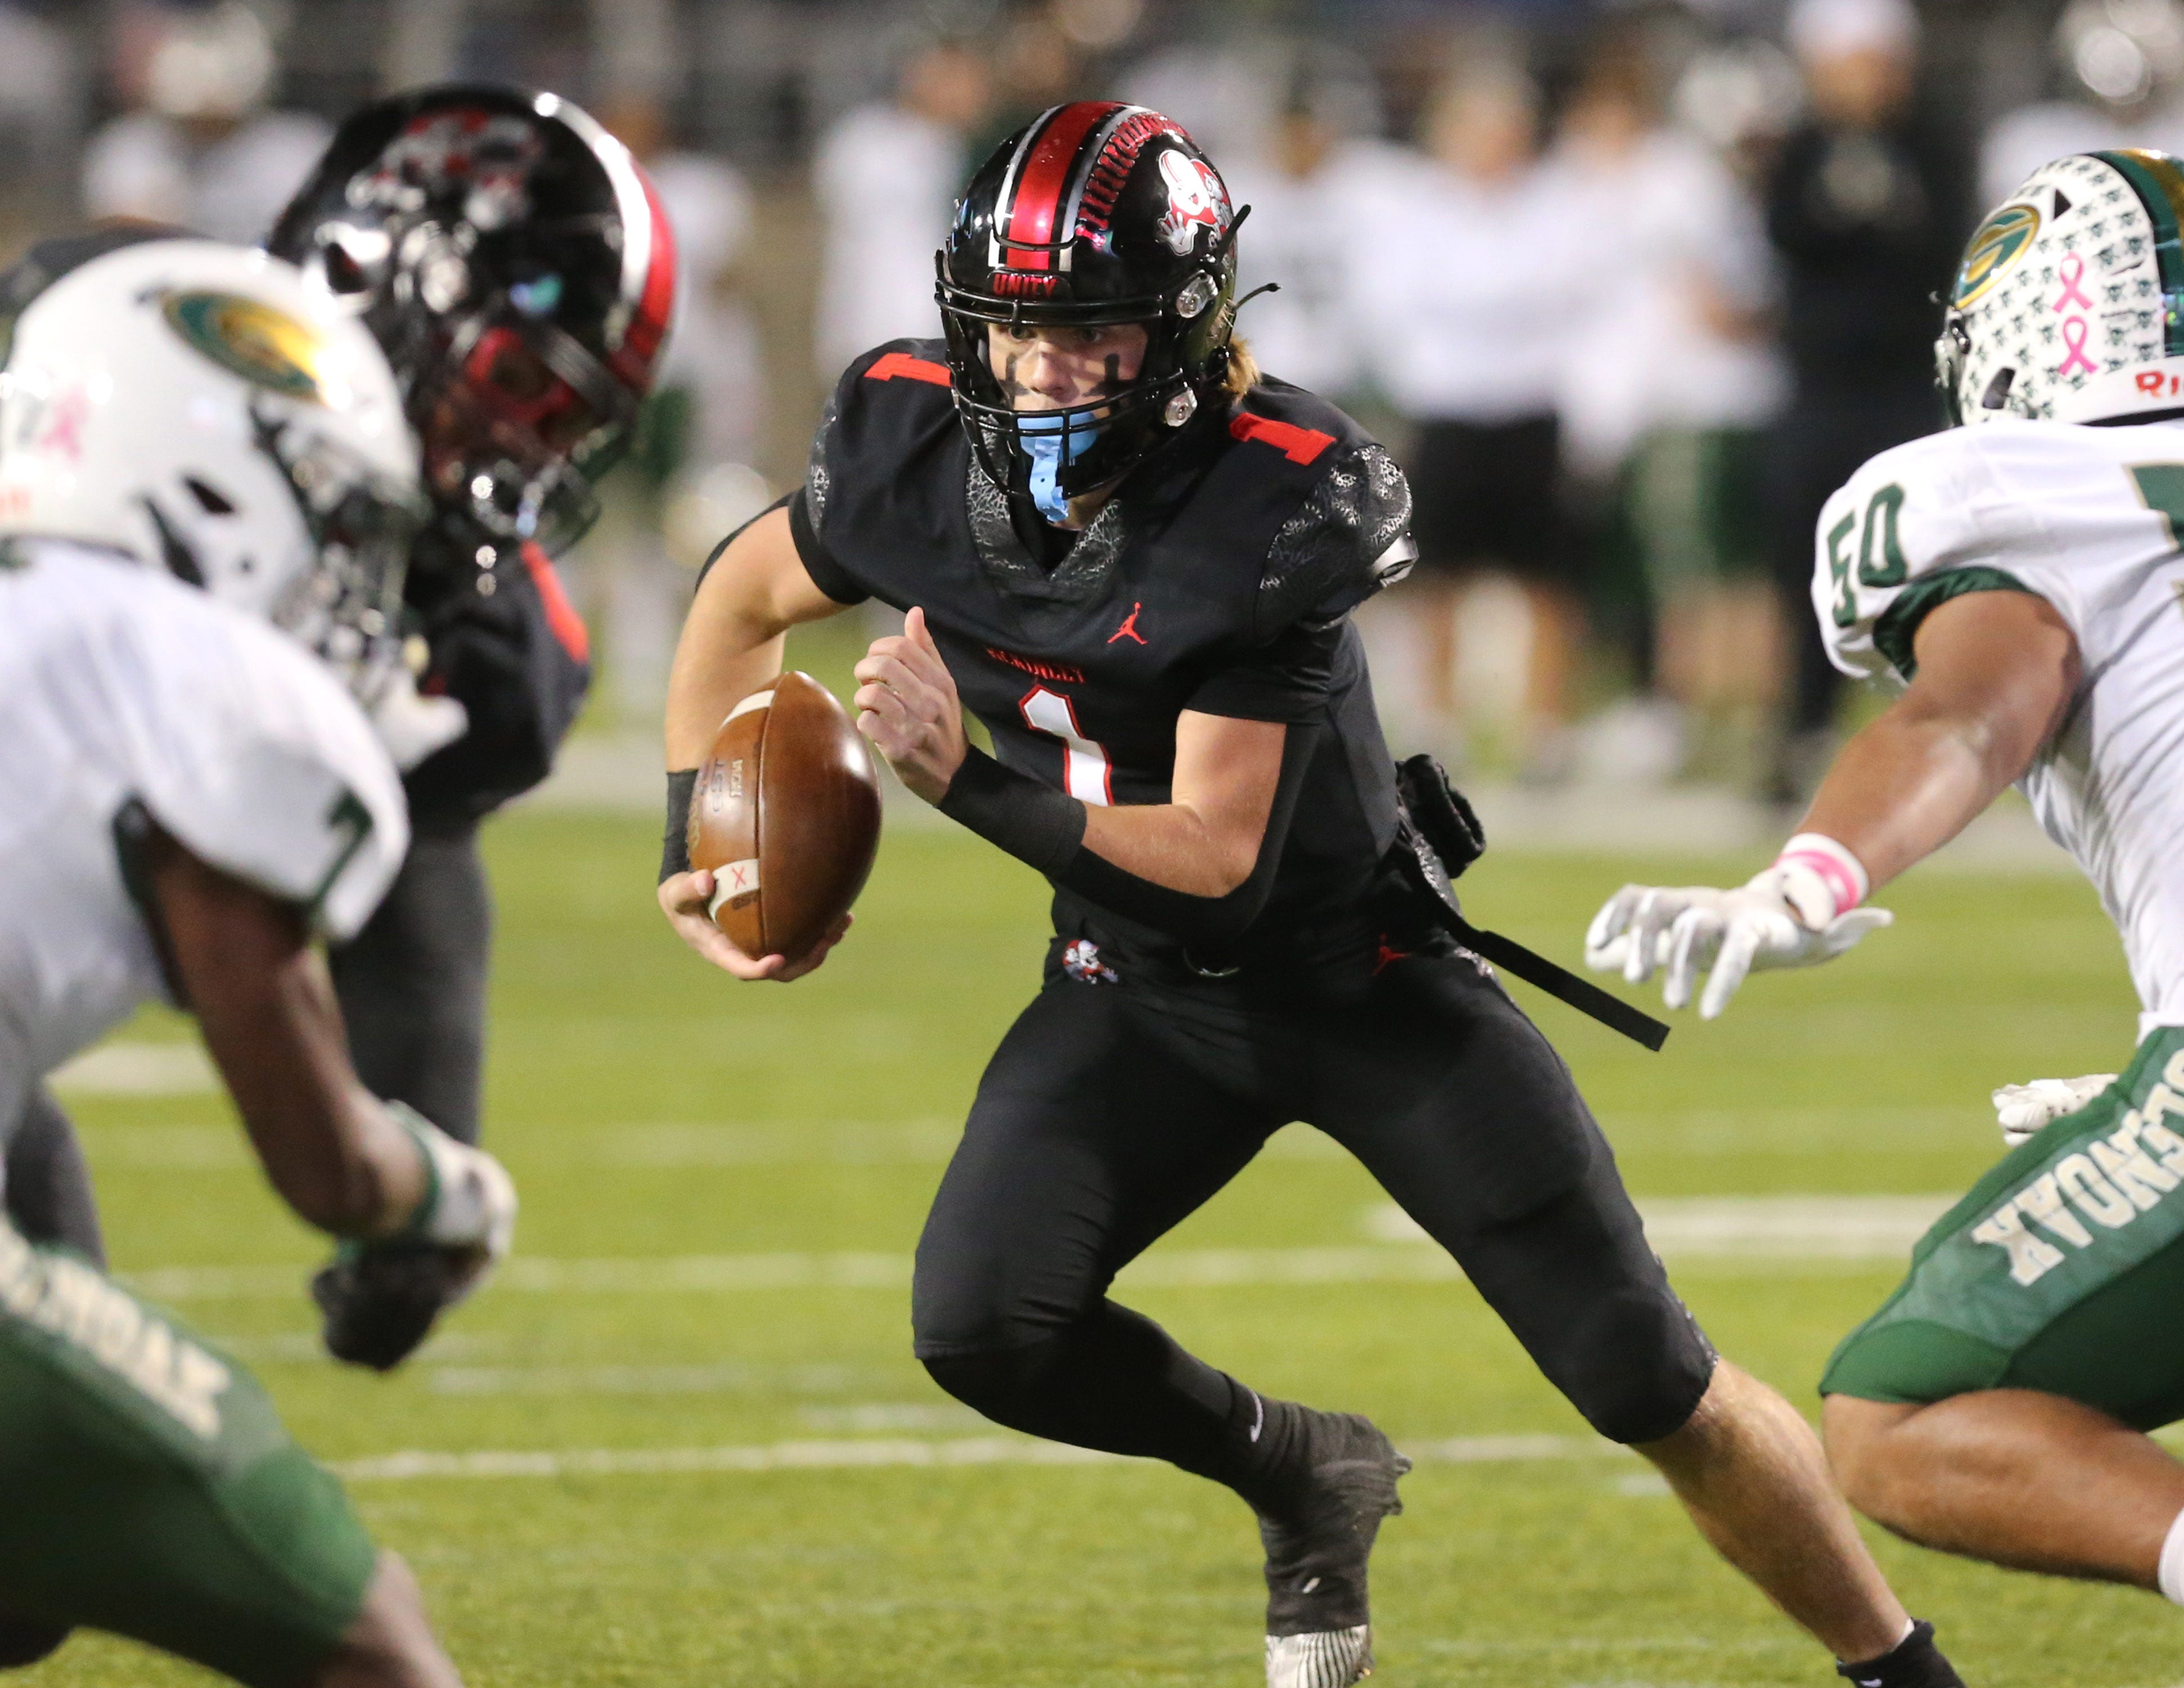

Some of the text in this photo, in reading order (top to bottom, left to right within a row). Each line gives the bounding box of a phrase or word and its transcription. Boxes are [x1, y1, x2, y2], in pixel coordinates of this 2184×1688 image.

[992, 273, 1058, 298] UNITY
[1229, 412, 1337, 466] 1
[1827, 482, 1908, 628] 50
[1018, 684, 1115, 807] 1
